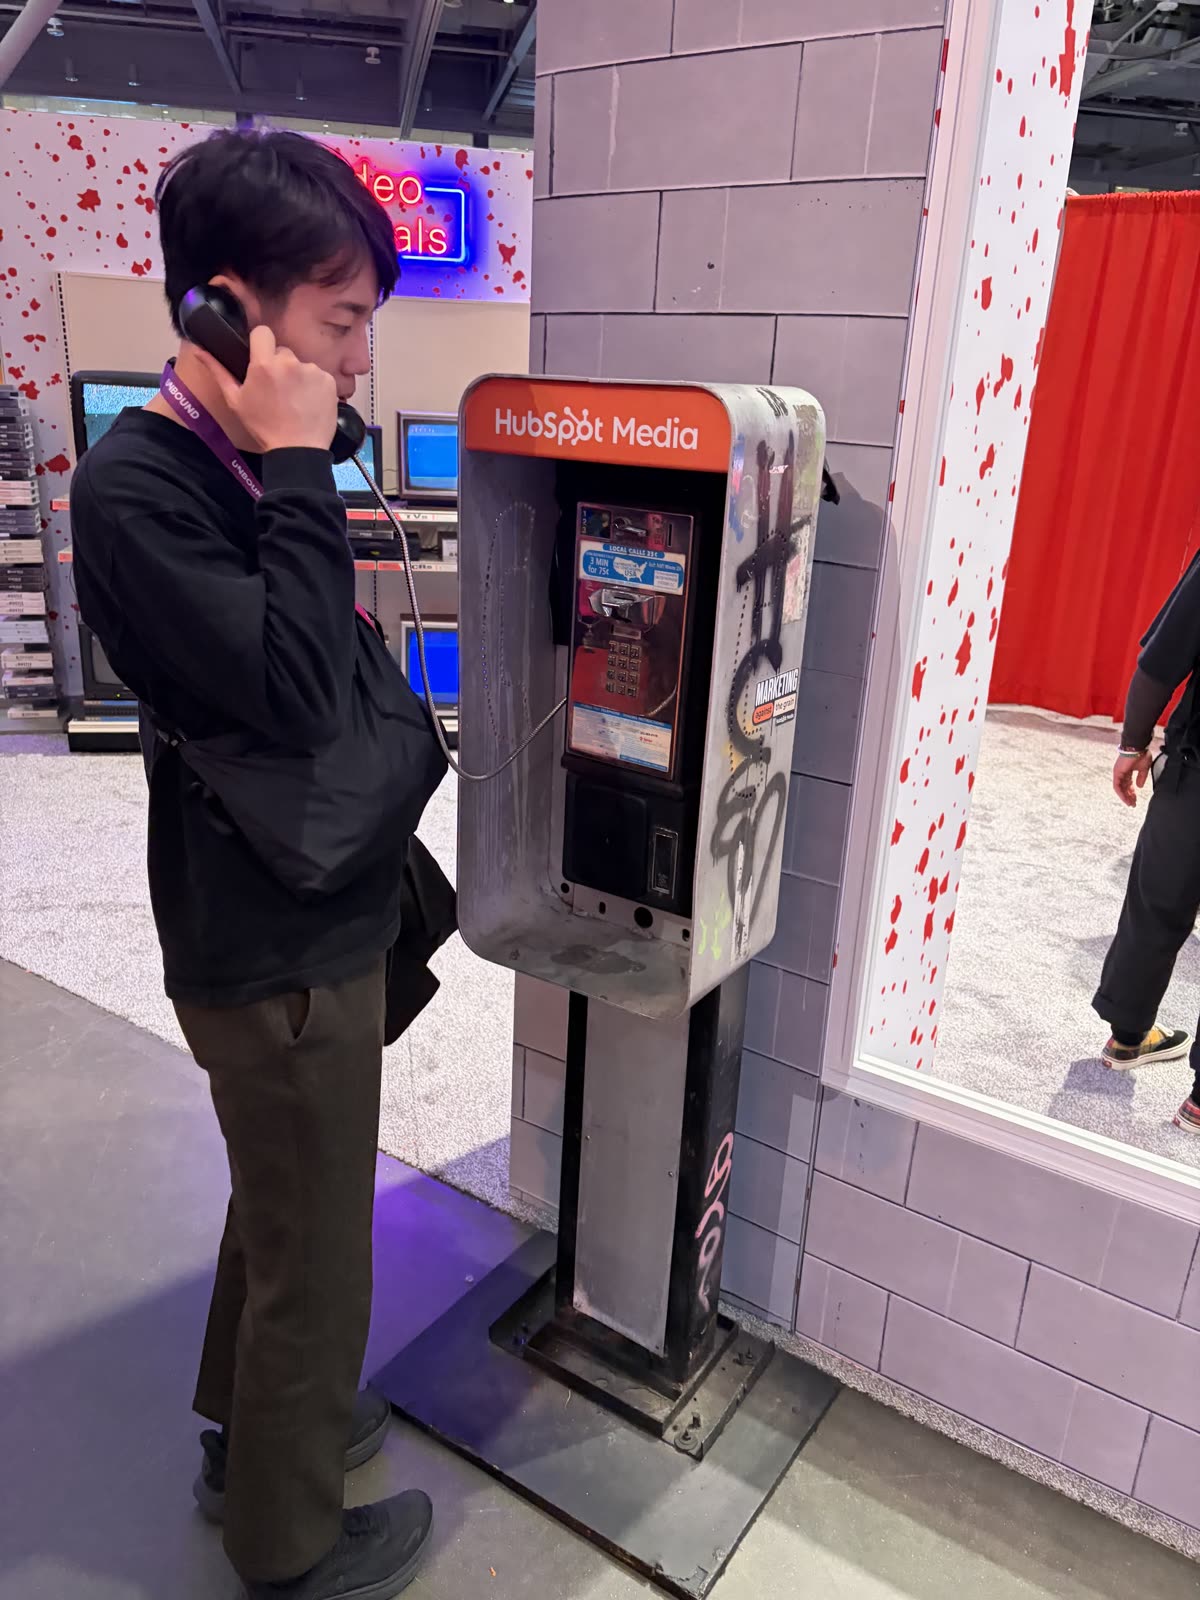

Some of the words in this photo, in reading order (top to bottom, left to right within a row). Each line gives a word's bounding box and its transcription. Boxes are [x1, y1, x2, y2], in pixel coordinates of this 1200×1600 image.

[356, 163, 422, 205] deo
[394, 217, 447, 255] als
[495, 406, 604, 447] HubSpot
[612, 416, 699, 450] Media
[231, 459, 264, 498] UNBOUN
[590, 557, 594, 565] 3
[595, 558, 609, 567] MIN
[609, 545, 627, 553] LOCAL
[628, 547, 646, 556] CALLS
[588, 566, 598, 574] for
[755, 668, 799, 707] MARKETING
